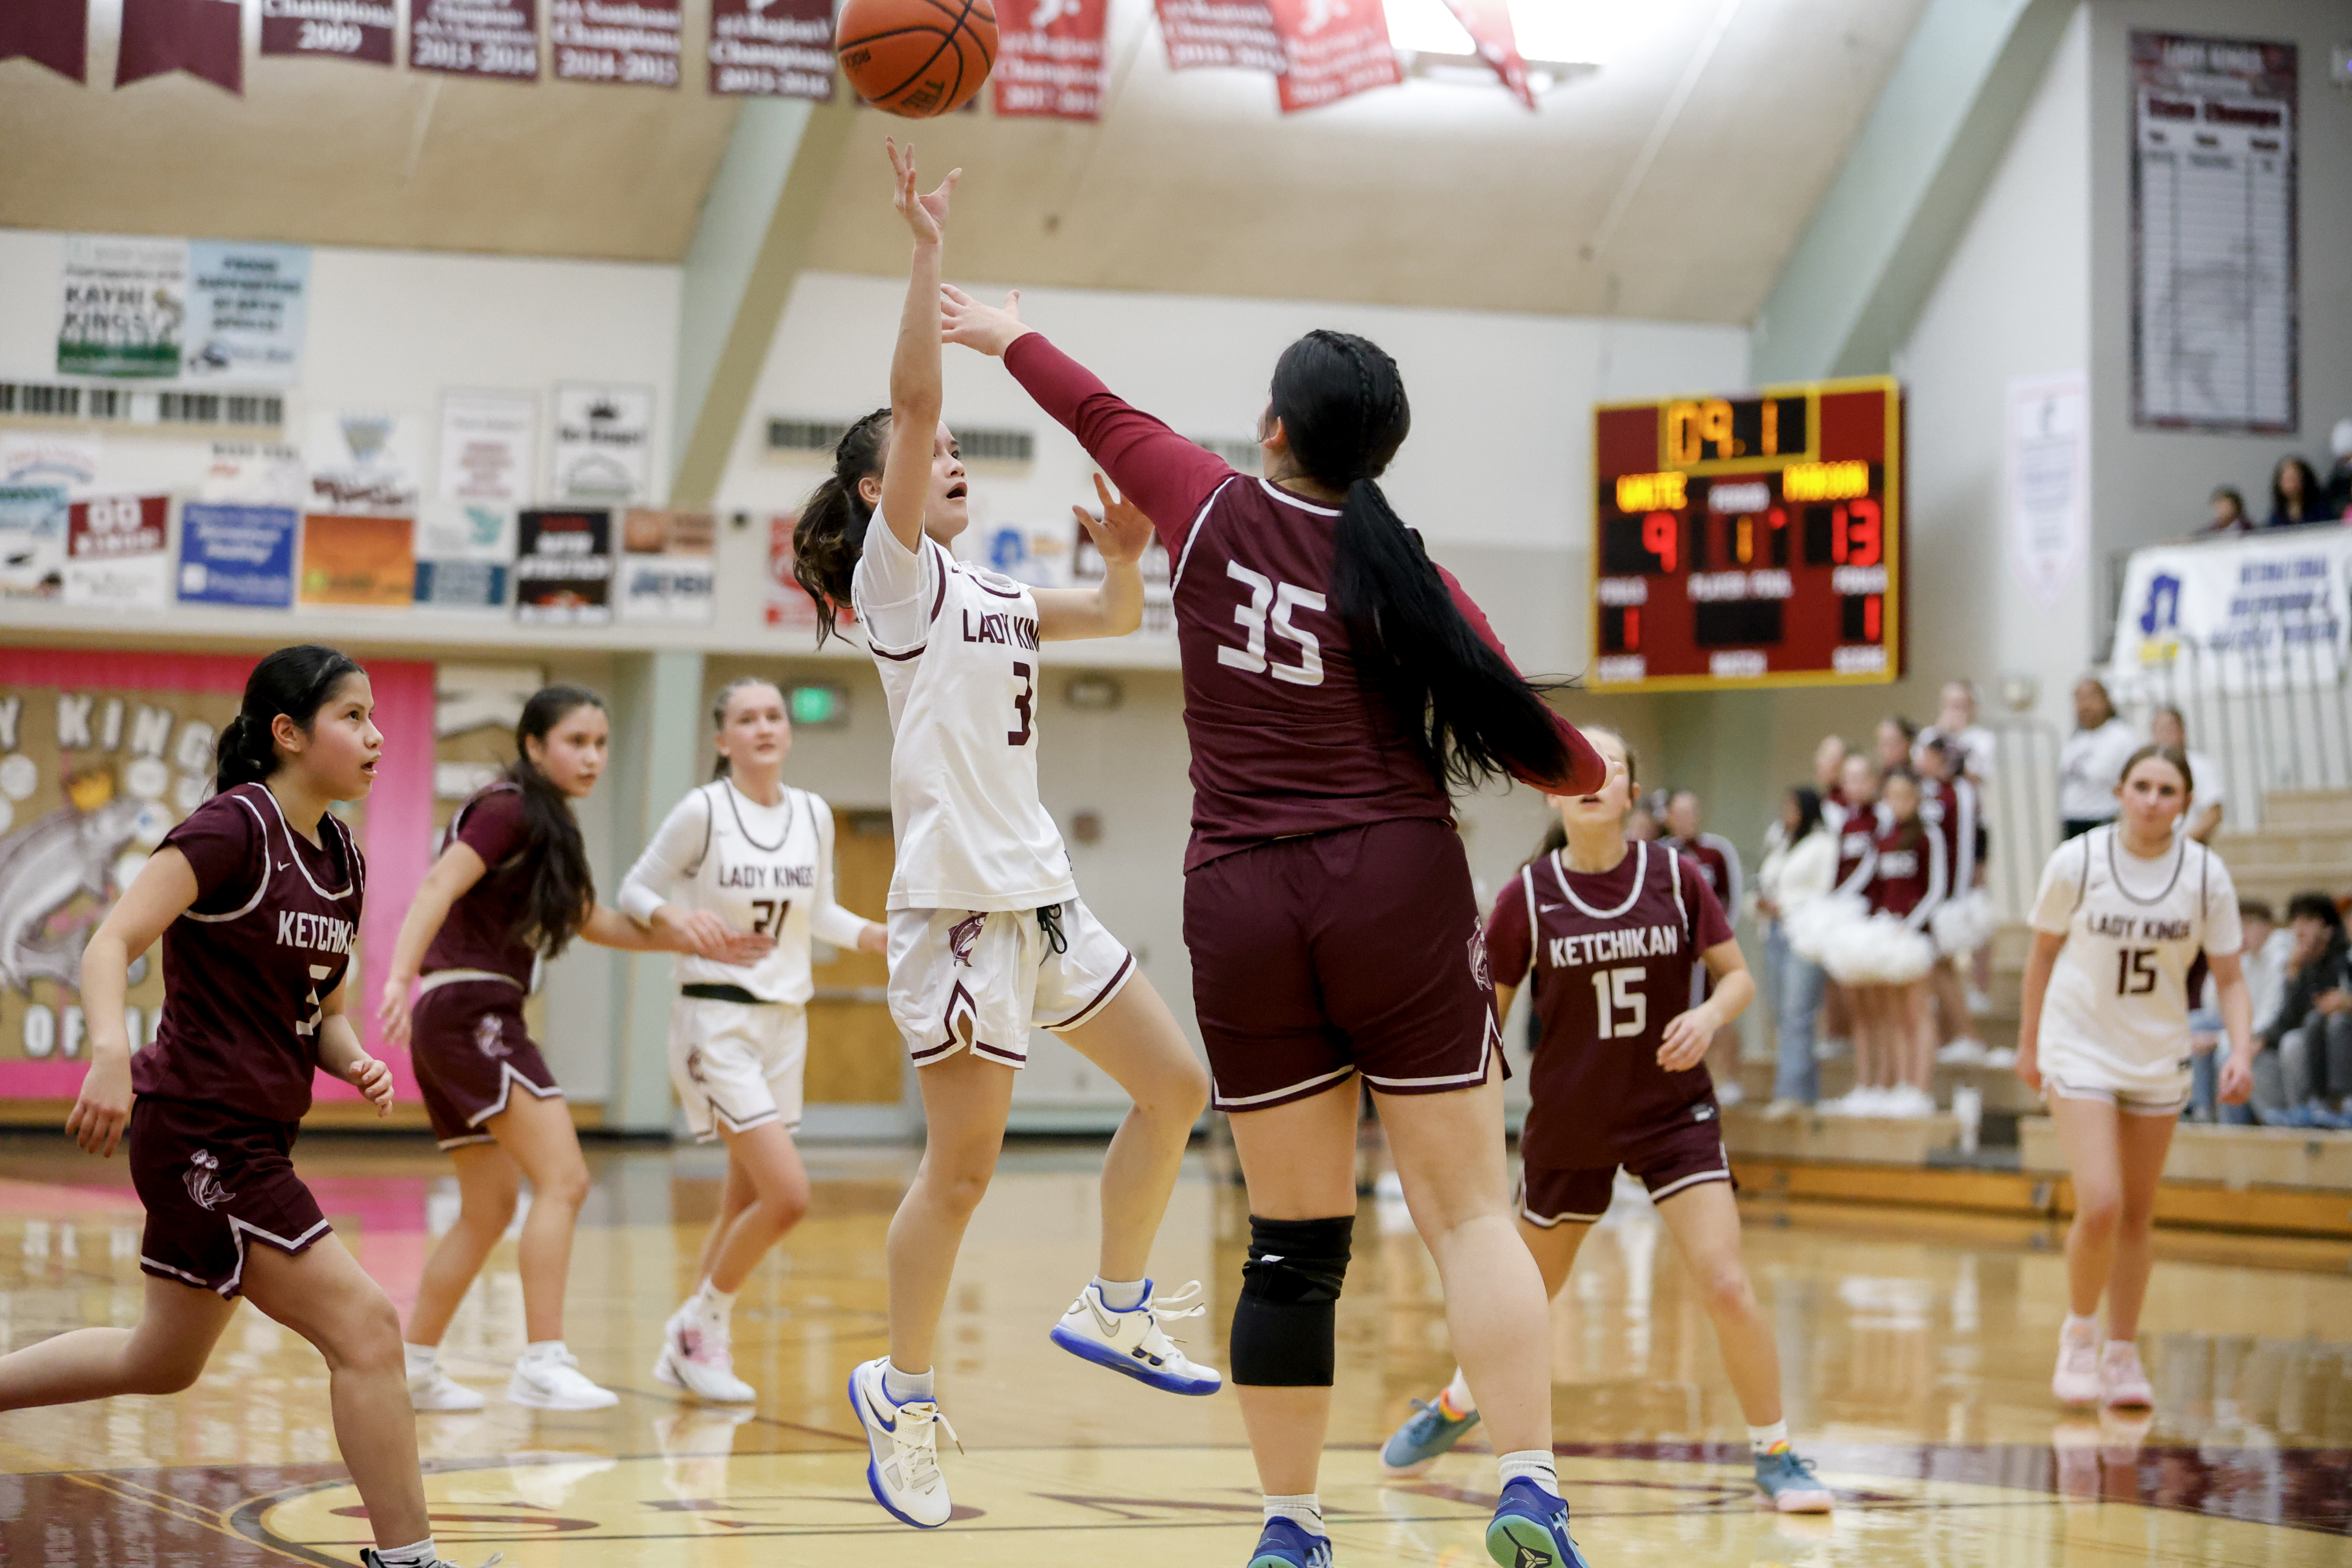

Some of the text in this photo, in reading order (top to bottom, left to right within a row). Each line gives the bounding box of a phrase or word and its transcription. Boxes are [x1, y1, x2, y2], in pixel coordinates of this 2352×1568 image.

[1642, 511, 1677, 572] 9
[1736, 515, 1753, 563] 1
[1831, 498, 1881, 566] 13
[963, 608, 1040, 653] LADY KIN
[1217, 551, 1327, 686] 35
[1623, 606, 1639, 651] 1
[1864, 594, 1880, 641] 1
[1007, 661, 1033, 746] 3
[57, 695, 220, 773] KING
[719, 864, 814, 888] LADY KINGS
[276, 910, 357, 956] KETCHIK
[1549, 924, 1679, 968] KETCHIKAN
[2087, 911, 2191, 942] LADY KINGS
[2118, 948, 2158, 995] 15
[1590, 966, 1647, 1040] 15
